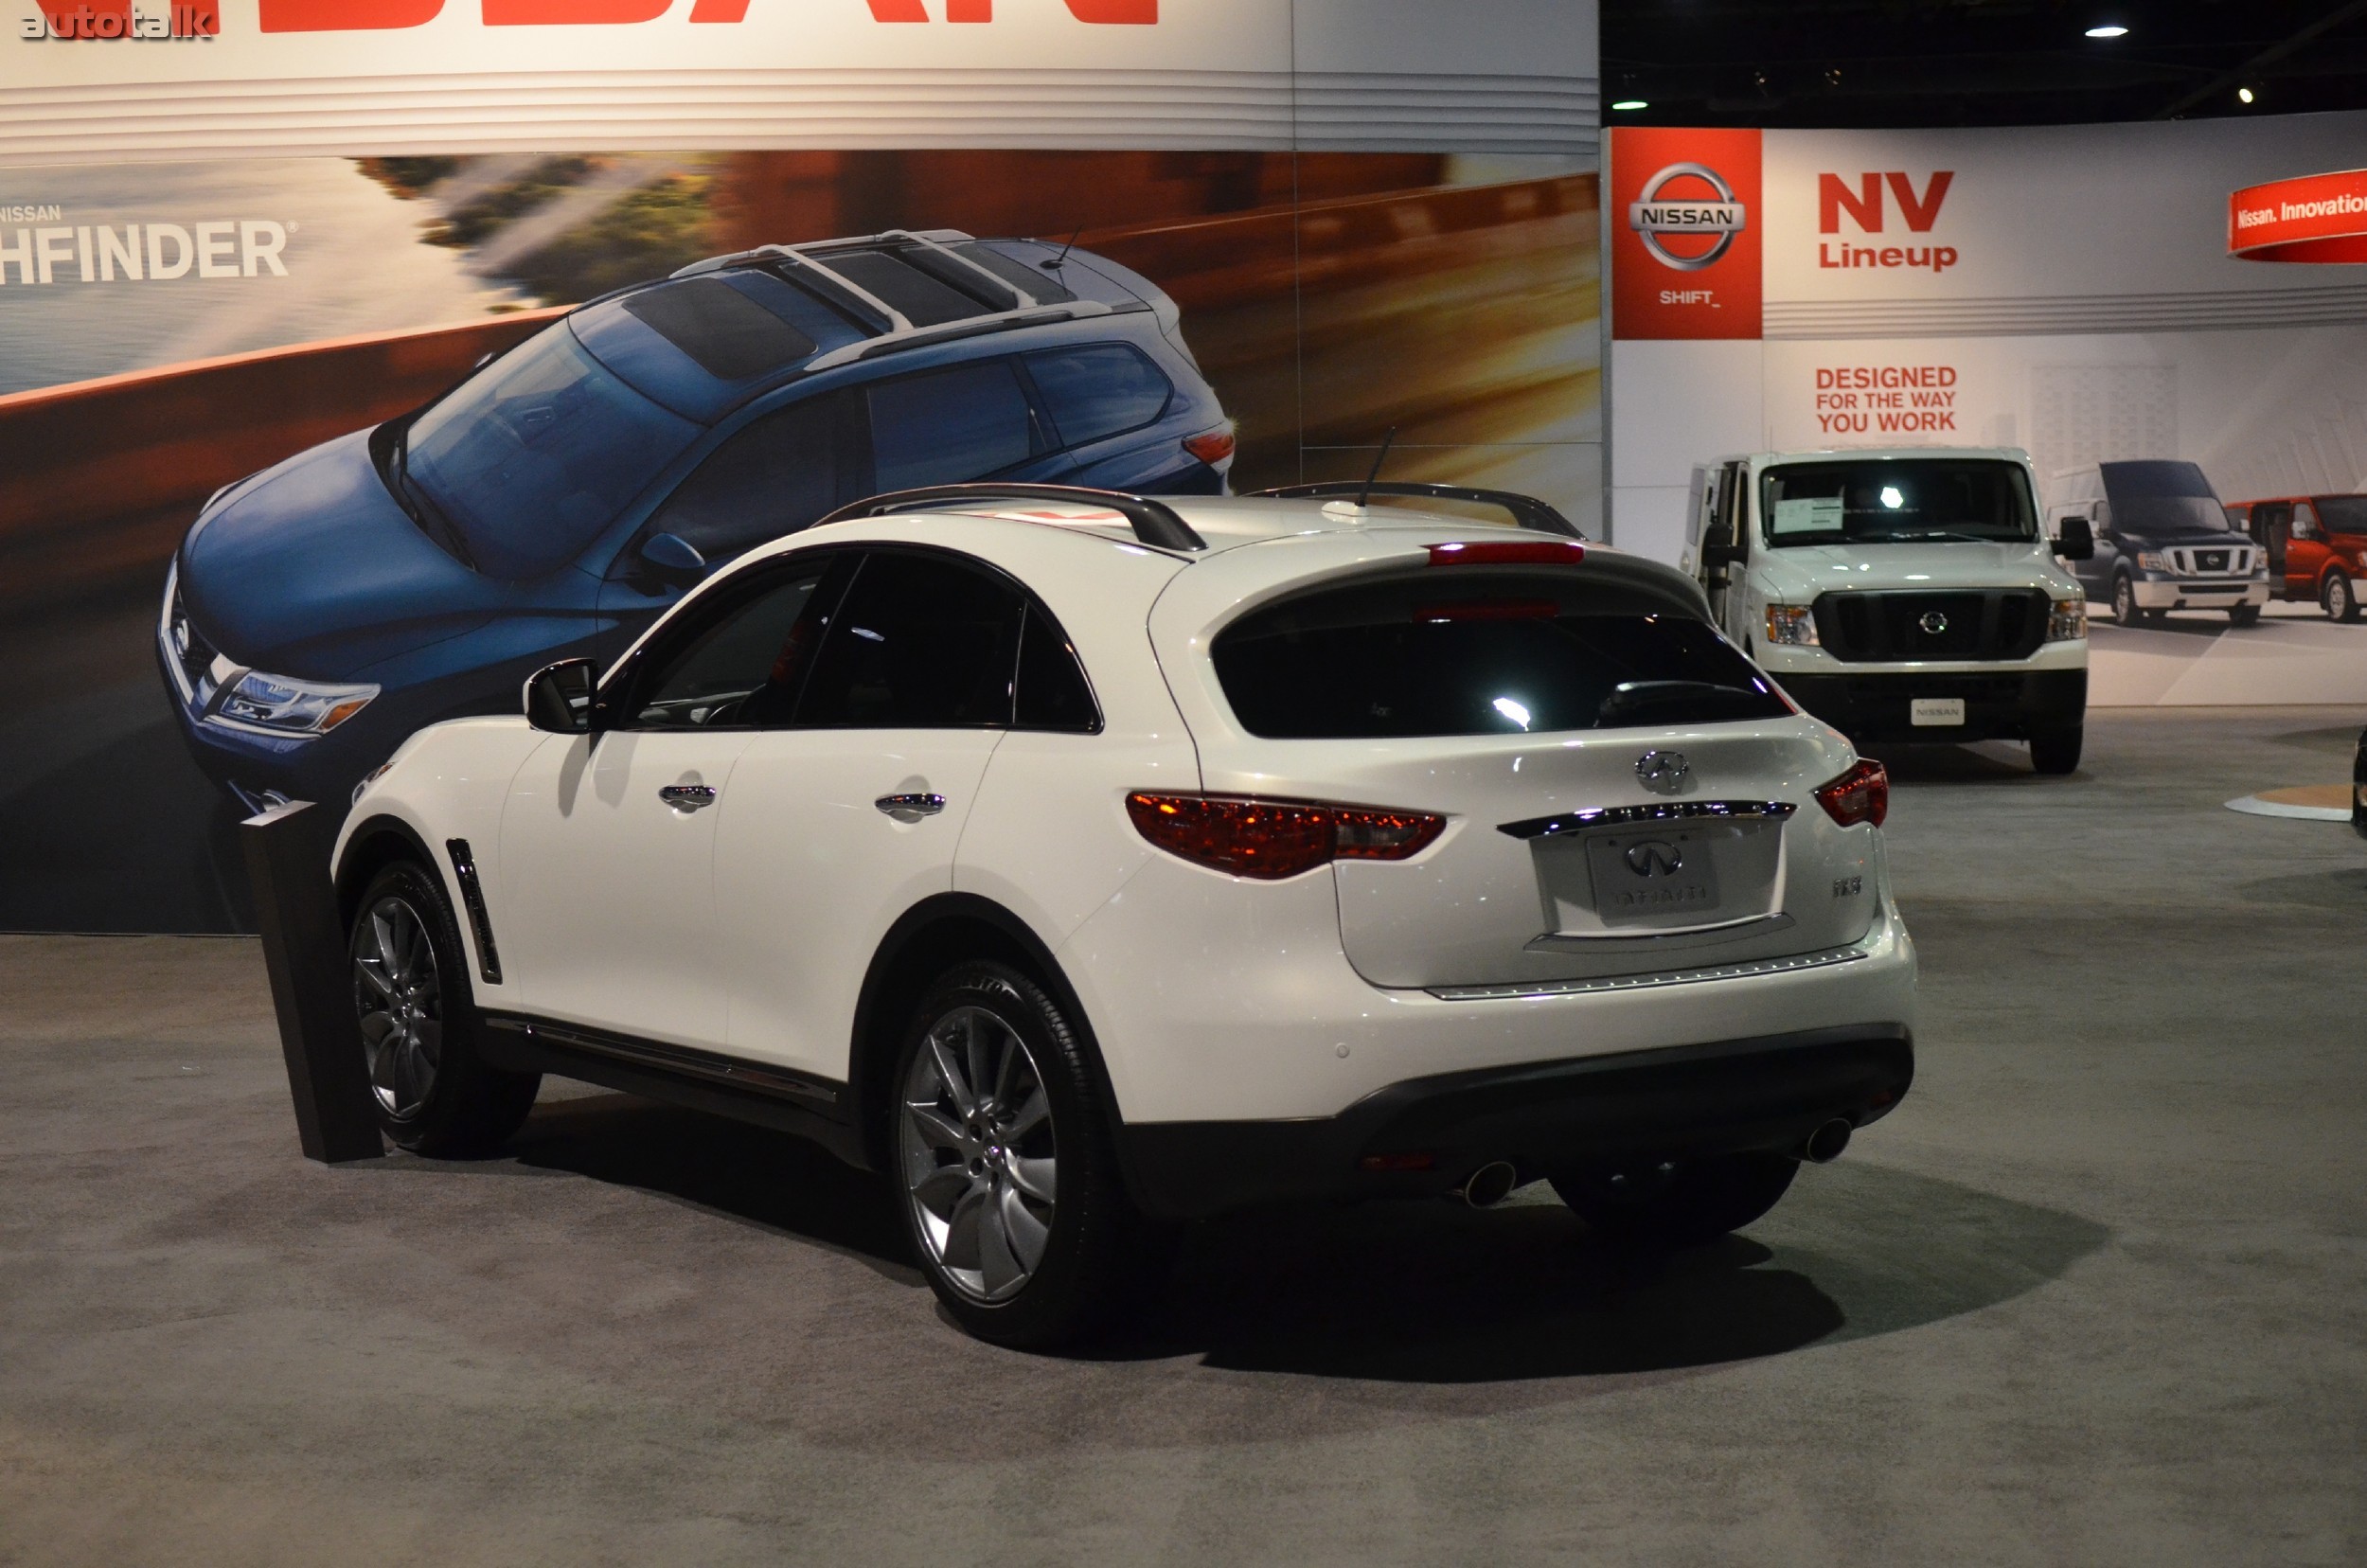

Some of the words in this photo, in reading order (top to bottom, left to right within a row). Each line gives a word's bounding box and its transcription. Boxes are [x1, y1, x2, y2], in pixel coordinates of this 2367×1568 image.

[1818, 170, 1954, 234] NV
[2237, 207, 2277, 229] Nissan.
[2281, 193, 2367, 222] Innovatio
[1641, 208, 1734, 225] NISSAN
[1818, 242, 1958, 273] Lineup
[1816, 366, 1957, 390] DESIGNED
[1816, 393, 1858, 409] FOR
[1864, 392, 1904, 408] THE
[1910, 391, 1956, 407] WAY
[1817, 413, 1869, 433] YOU
[1877, 411, 1956, 432] WORK
[1915, 708, 1960, 717] NISSAN
